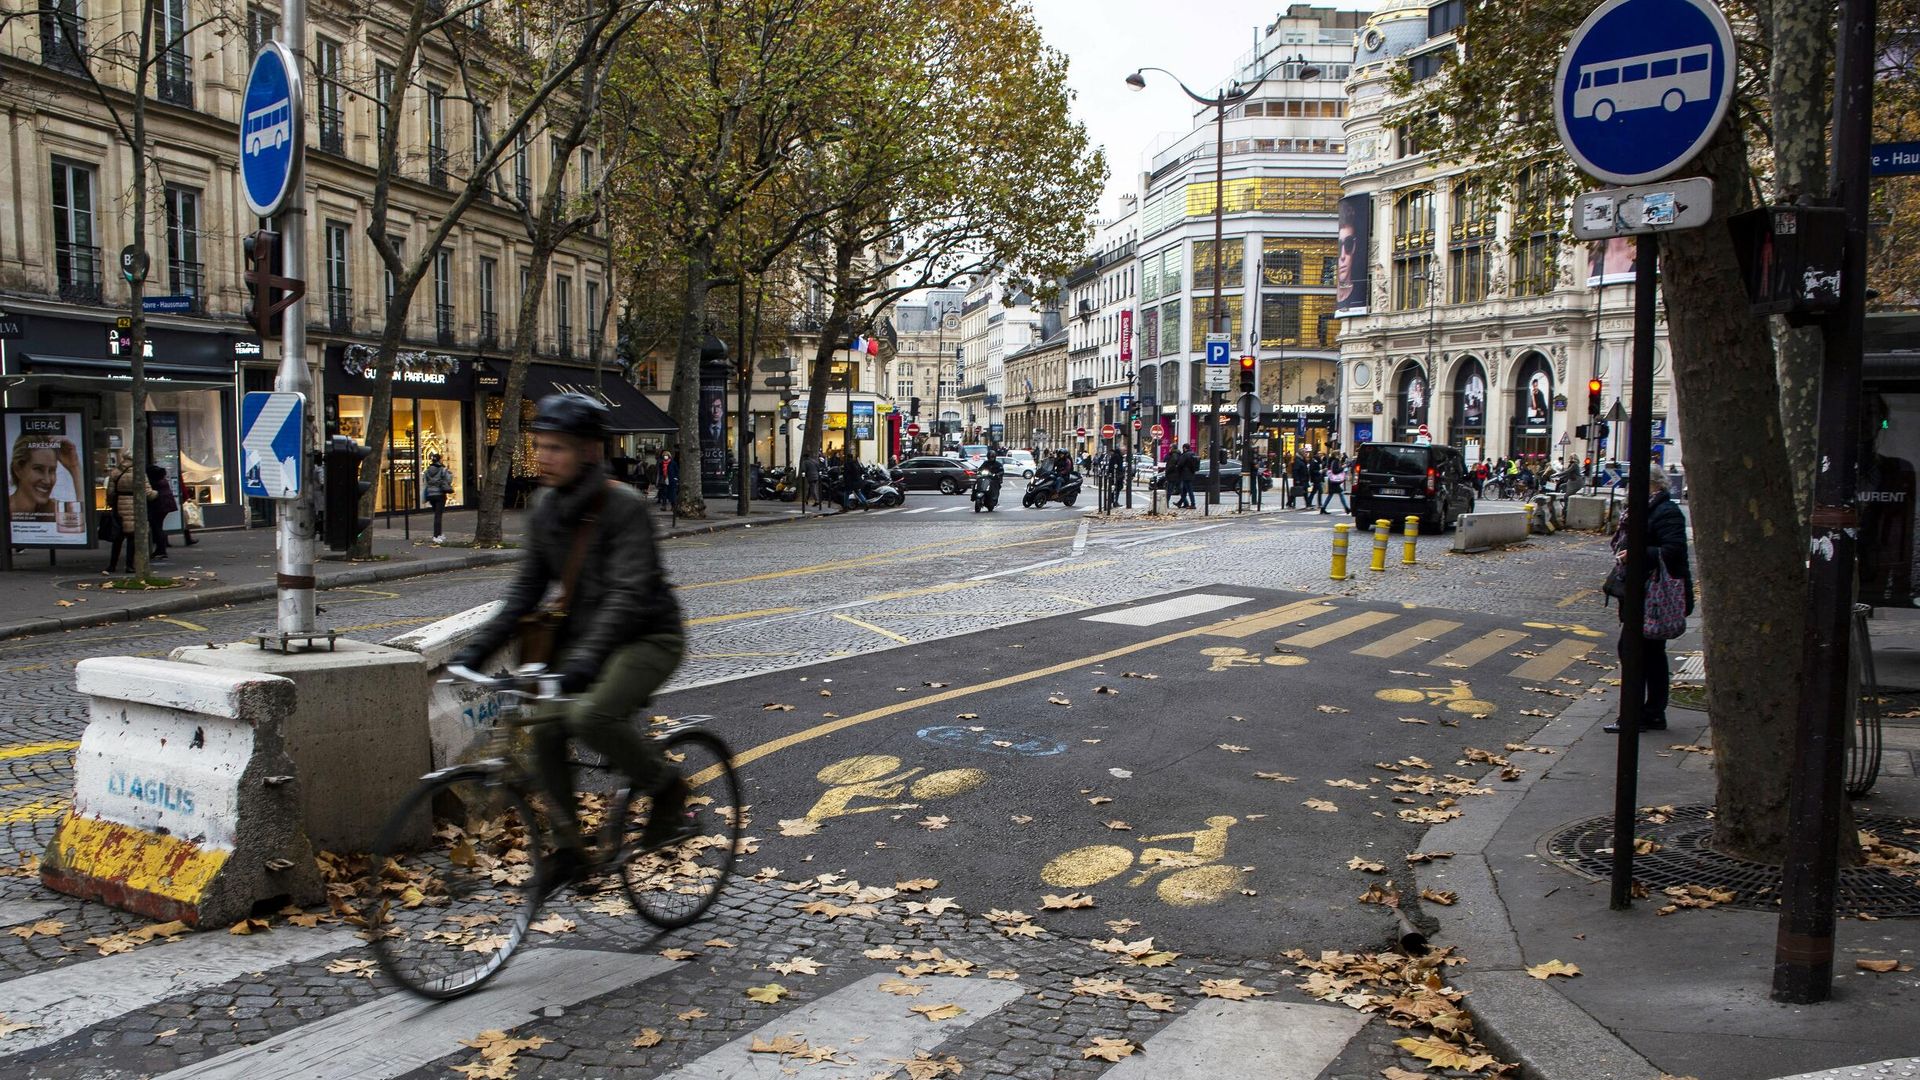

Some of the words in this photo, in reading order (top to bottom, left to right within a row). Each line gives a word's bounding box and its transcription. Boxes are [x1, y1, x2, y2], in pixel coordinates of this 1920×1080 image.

[119, 319, 130, 327] 42
[120, 338, 131, 347] 94
[1213, 345, 1225, 361] P
[404, 371, 446, 384] PARFUMEUR
[25, 421, 61, 430] LIERAC
